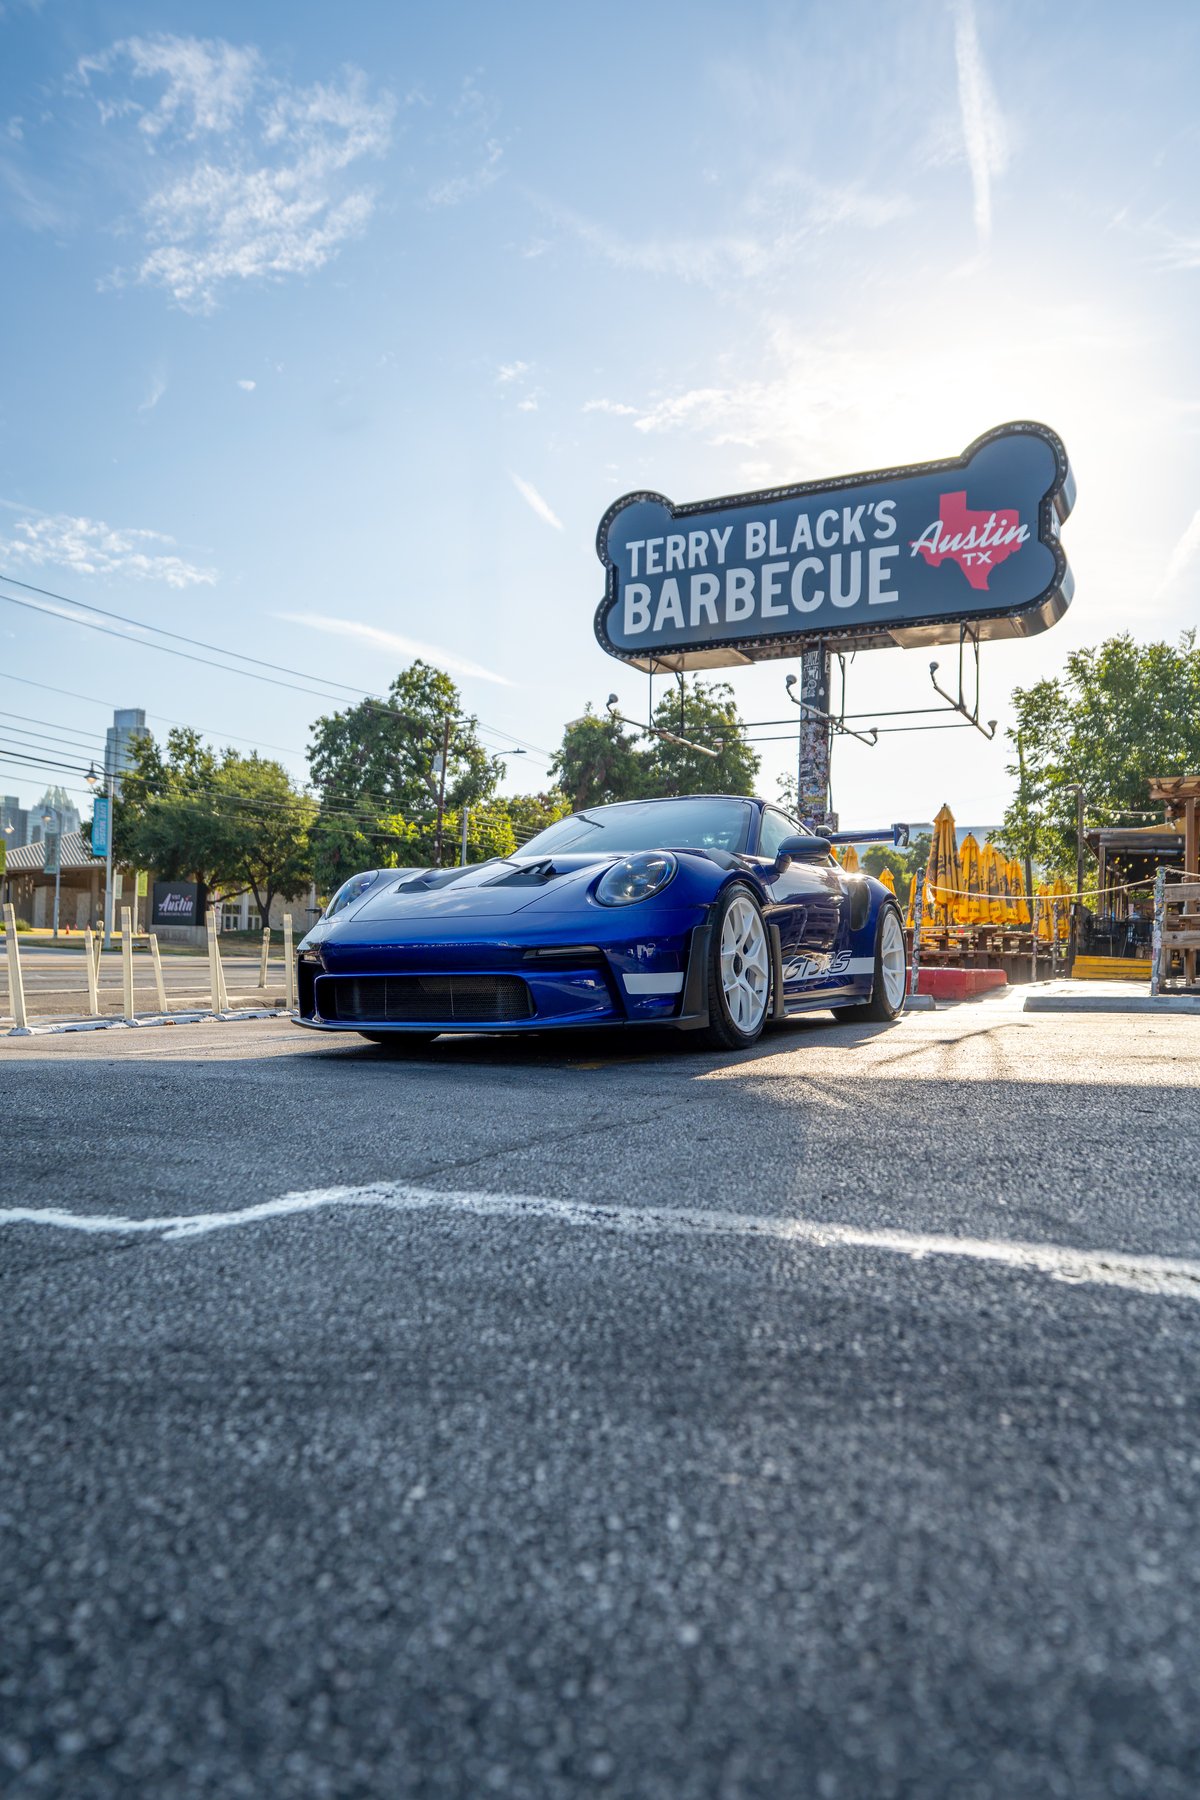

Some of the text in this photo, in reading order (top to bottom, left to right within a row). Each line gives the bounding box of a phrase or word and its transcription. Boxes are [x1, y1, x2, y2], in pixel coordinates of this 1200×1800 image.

[626, 500, 897, 577] TERRY BLACK'S
[911, 513, 1031, 557] Austin
[963, 552, 992, 567] TX
[624, 546, 899, 635] BARBECUE
[158, 893, 193, 912] Austin
